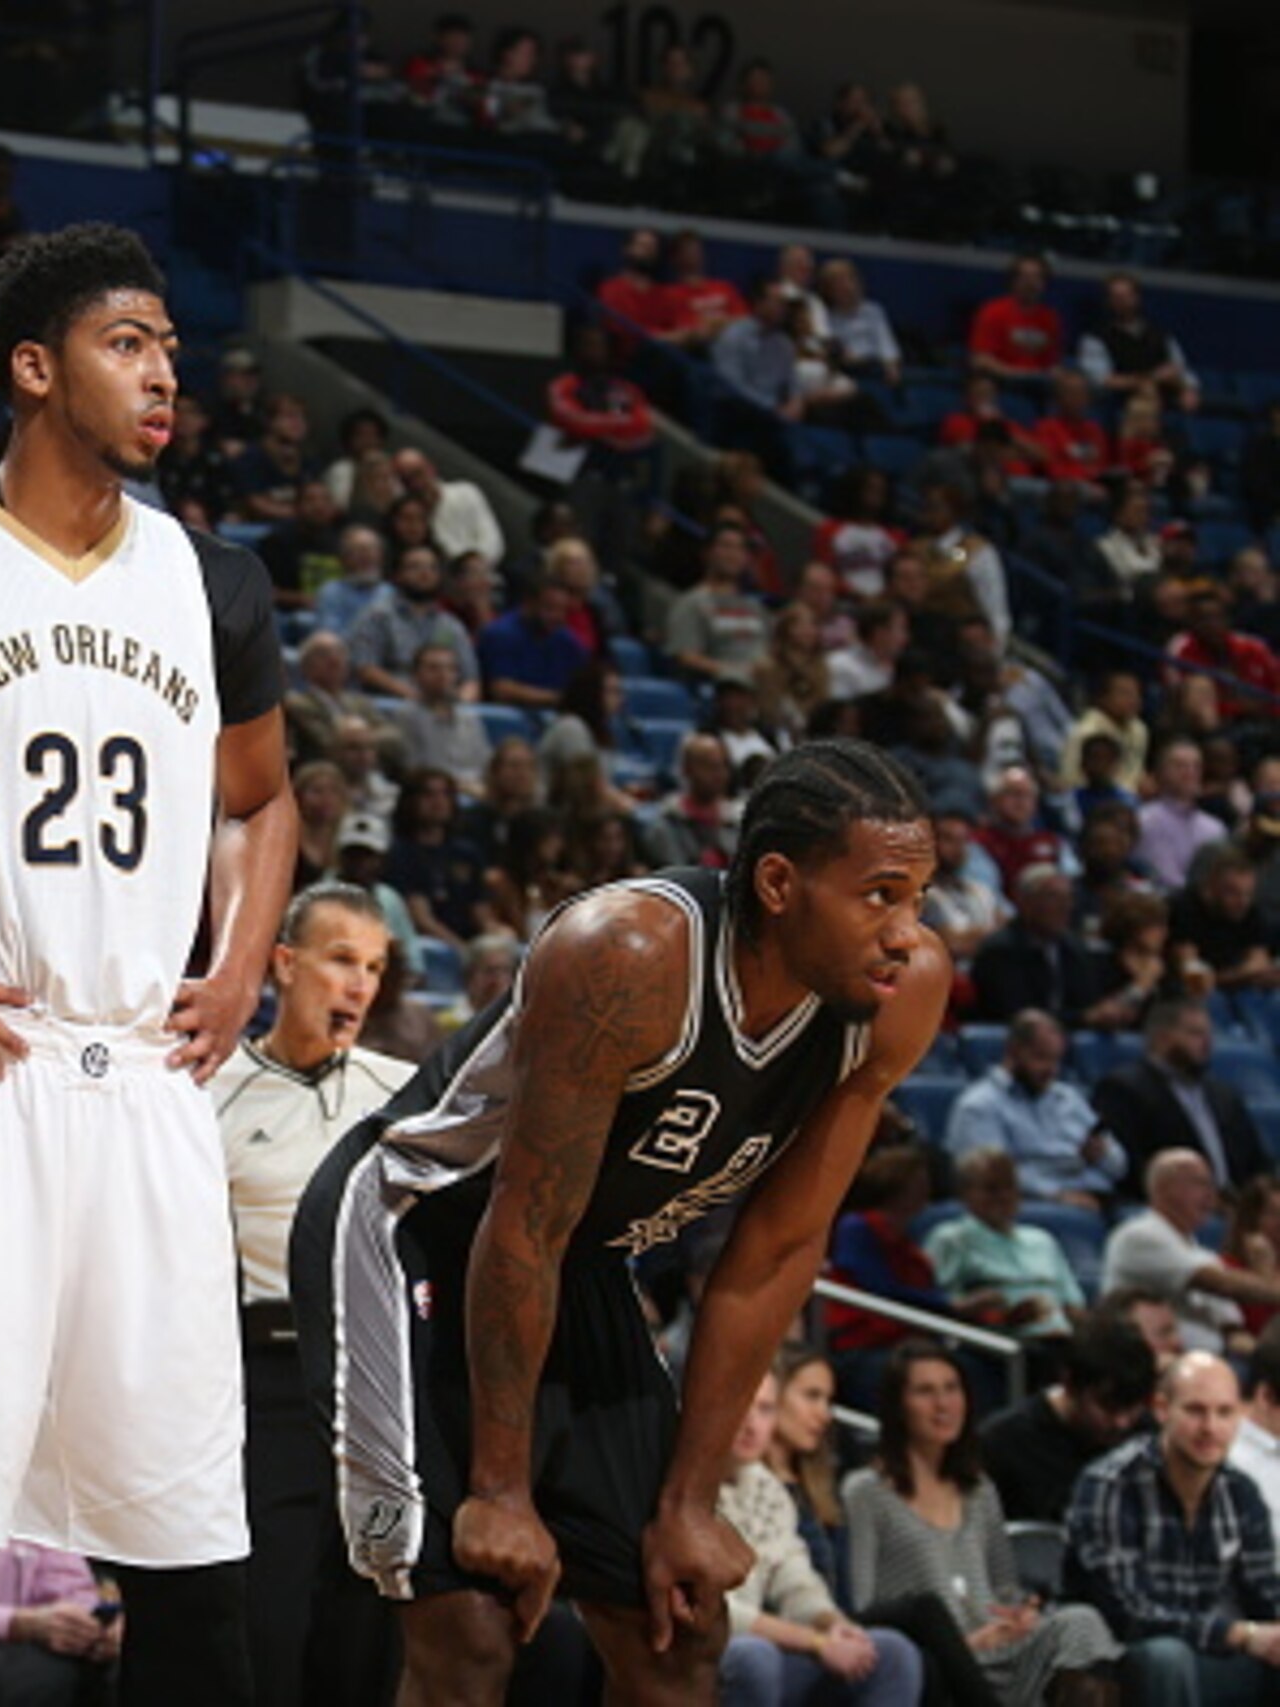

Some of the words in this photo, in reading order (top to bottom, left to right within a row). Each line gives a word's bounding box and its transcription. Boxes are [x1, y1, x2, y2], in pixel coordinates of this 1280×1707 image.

[51, 623, 200, 725] ORLEANS
[21, 731, 149, 874] 23
[627, 1087, 722, 1174] 2
